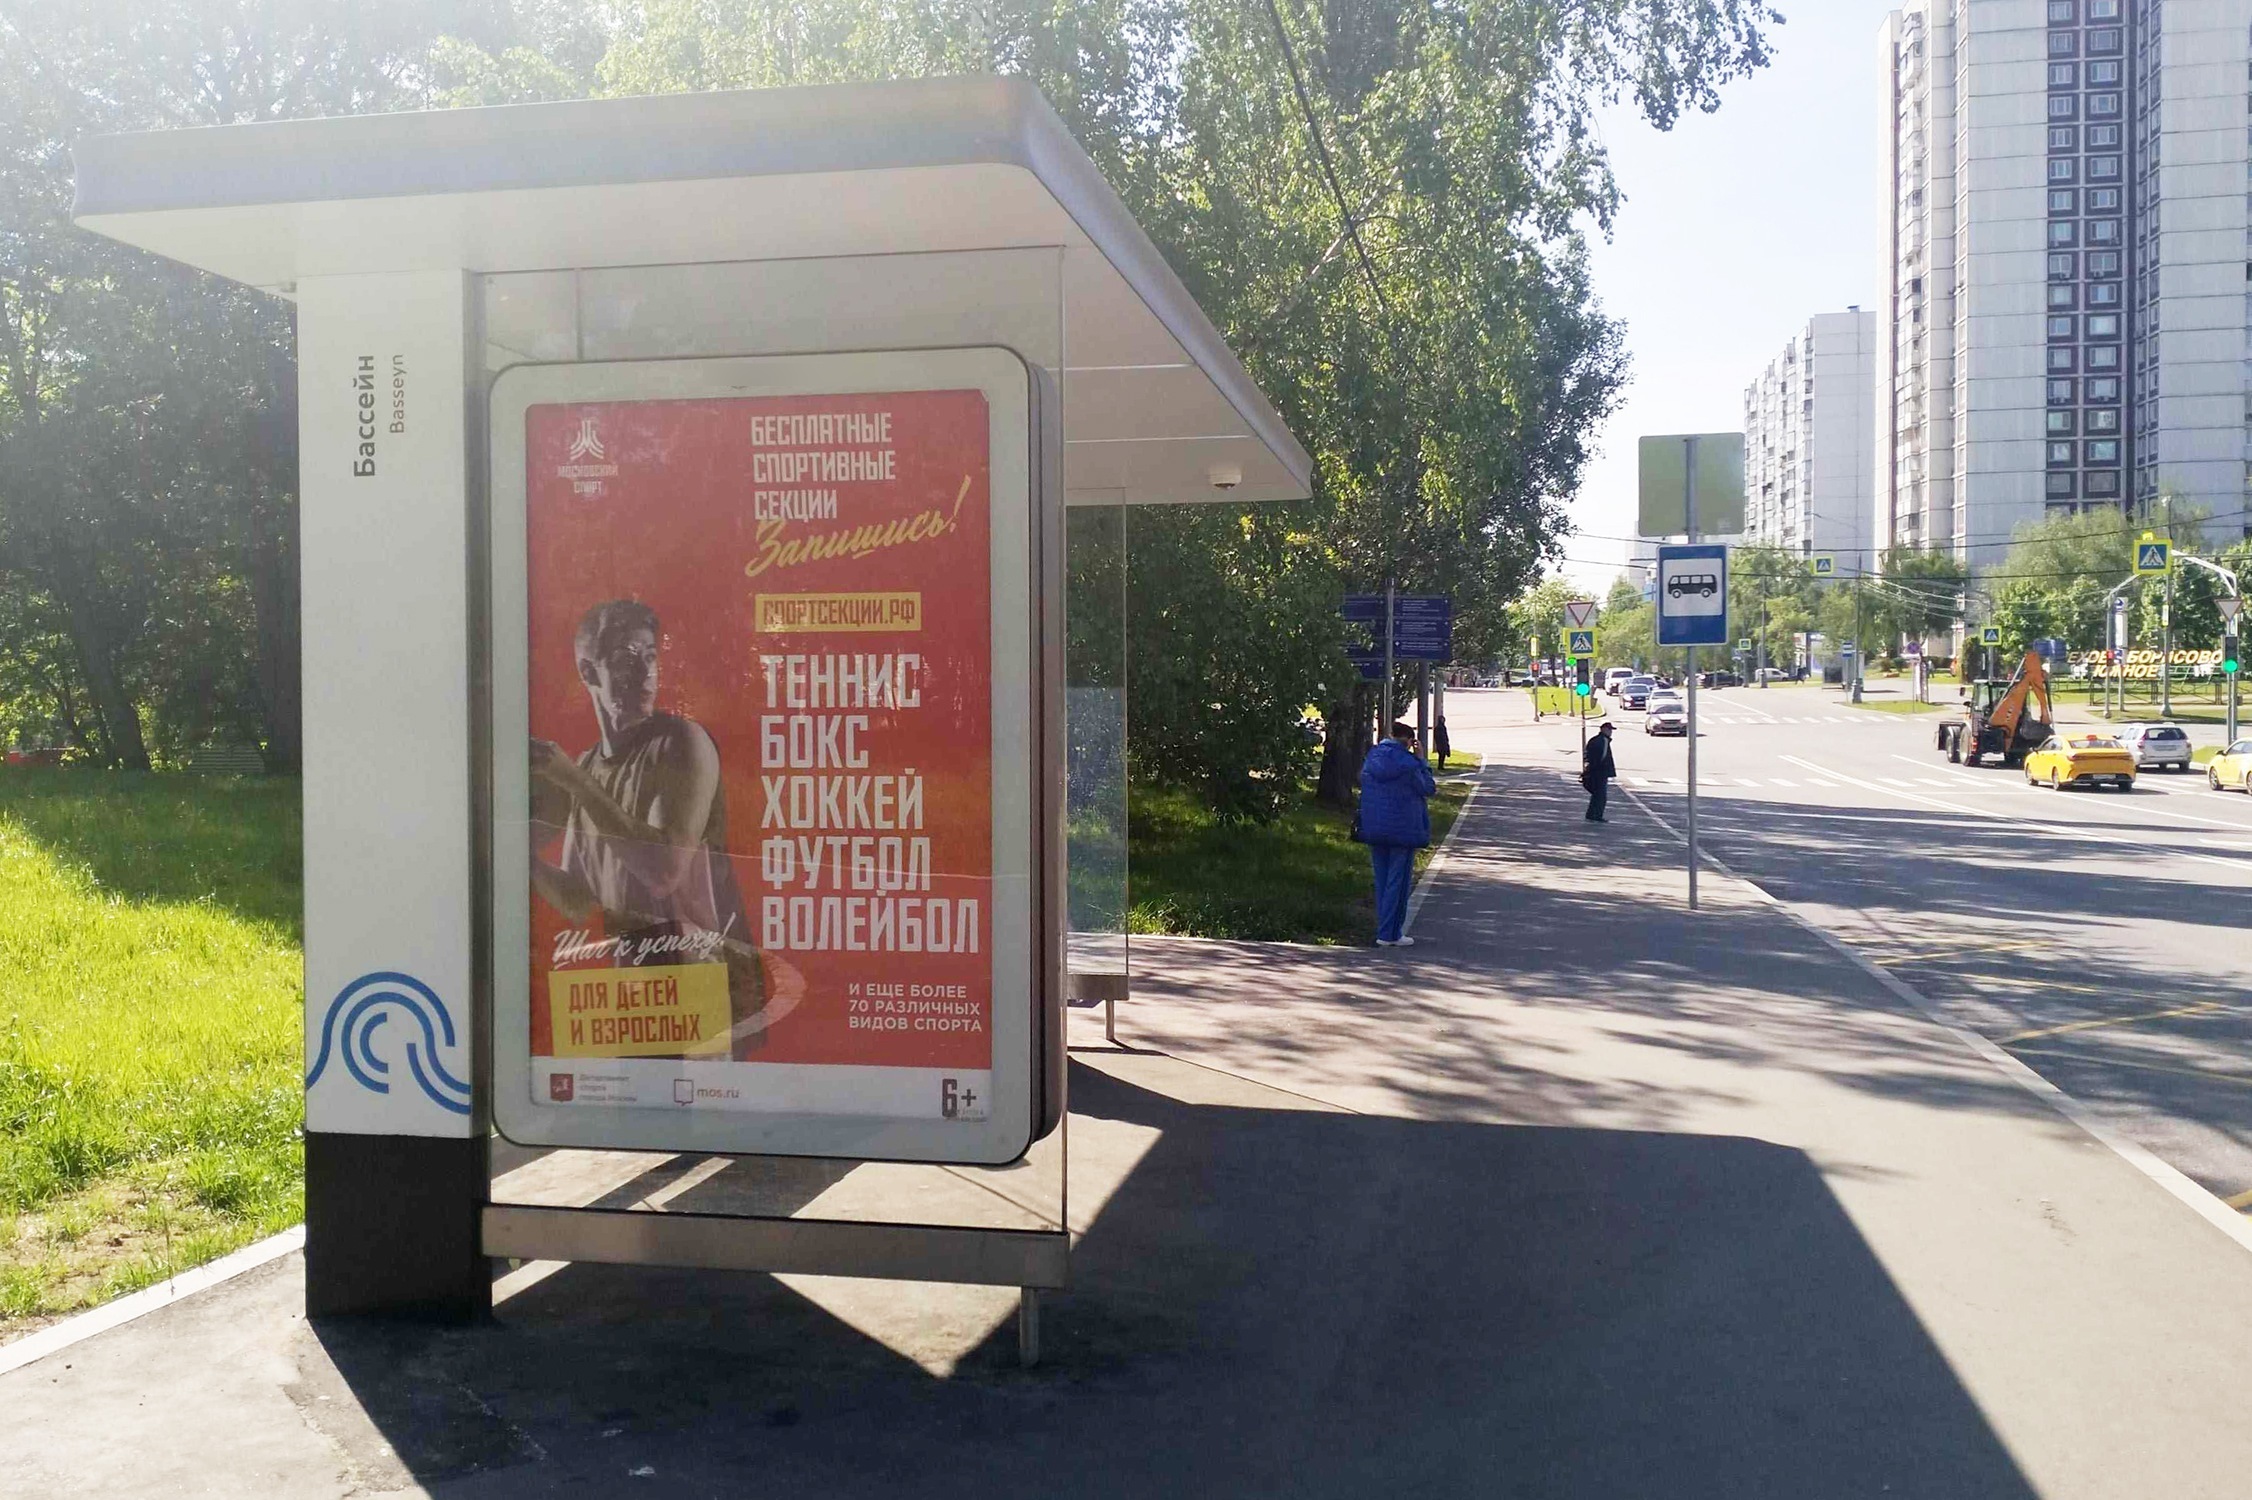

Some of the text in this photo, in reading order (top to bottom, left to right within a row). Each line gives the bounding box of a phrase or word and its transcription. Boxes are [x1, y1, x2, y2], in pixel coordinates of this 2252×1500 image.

[389, 354, 407, 434] Basseyn
[353, 355, 375, 478] Бассейн
[751, 412, 892, 446] БЕСПЛАТНЫЕ
[753, 450, 896, 483] СПОРТИВНЫЕ
[744, 474, 971, 577] Запишись!
[754, 489, 838, 523] СЕКЦИИ
[763, 598, 915, 627] СПОРТСЕКЦИИ.РФ
[759, 653, 921, 709] ТЕННИС
[761, 714, 869, 769] БОКС
[761, 768, 924, 829] ХОККЕЙ
[762, 835, 931, 891] ФУТБОЛ
[552, 912, 737, 970] Шаг к успеху!
[762, 890, 979, 954] ВОЛЕЙБОЛ
[569, 975, 679, 1014] ДЛЯ ДЕТЕЙ
[849, 983, 967, 998] И ЕЩЕ БОЛЕЕ
[849, 999, 980, 1016] 70 РАЗЛИЧНЫХ
[570, 1014, 701, 1046] И ВЗРОСЛЫХ
[849, 1016, 982, 1032] ВИДОВ СПОРТА
[697, 1087, 740, 1099] mos.ru
[942, 1078, 977, 1118] 6+
